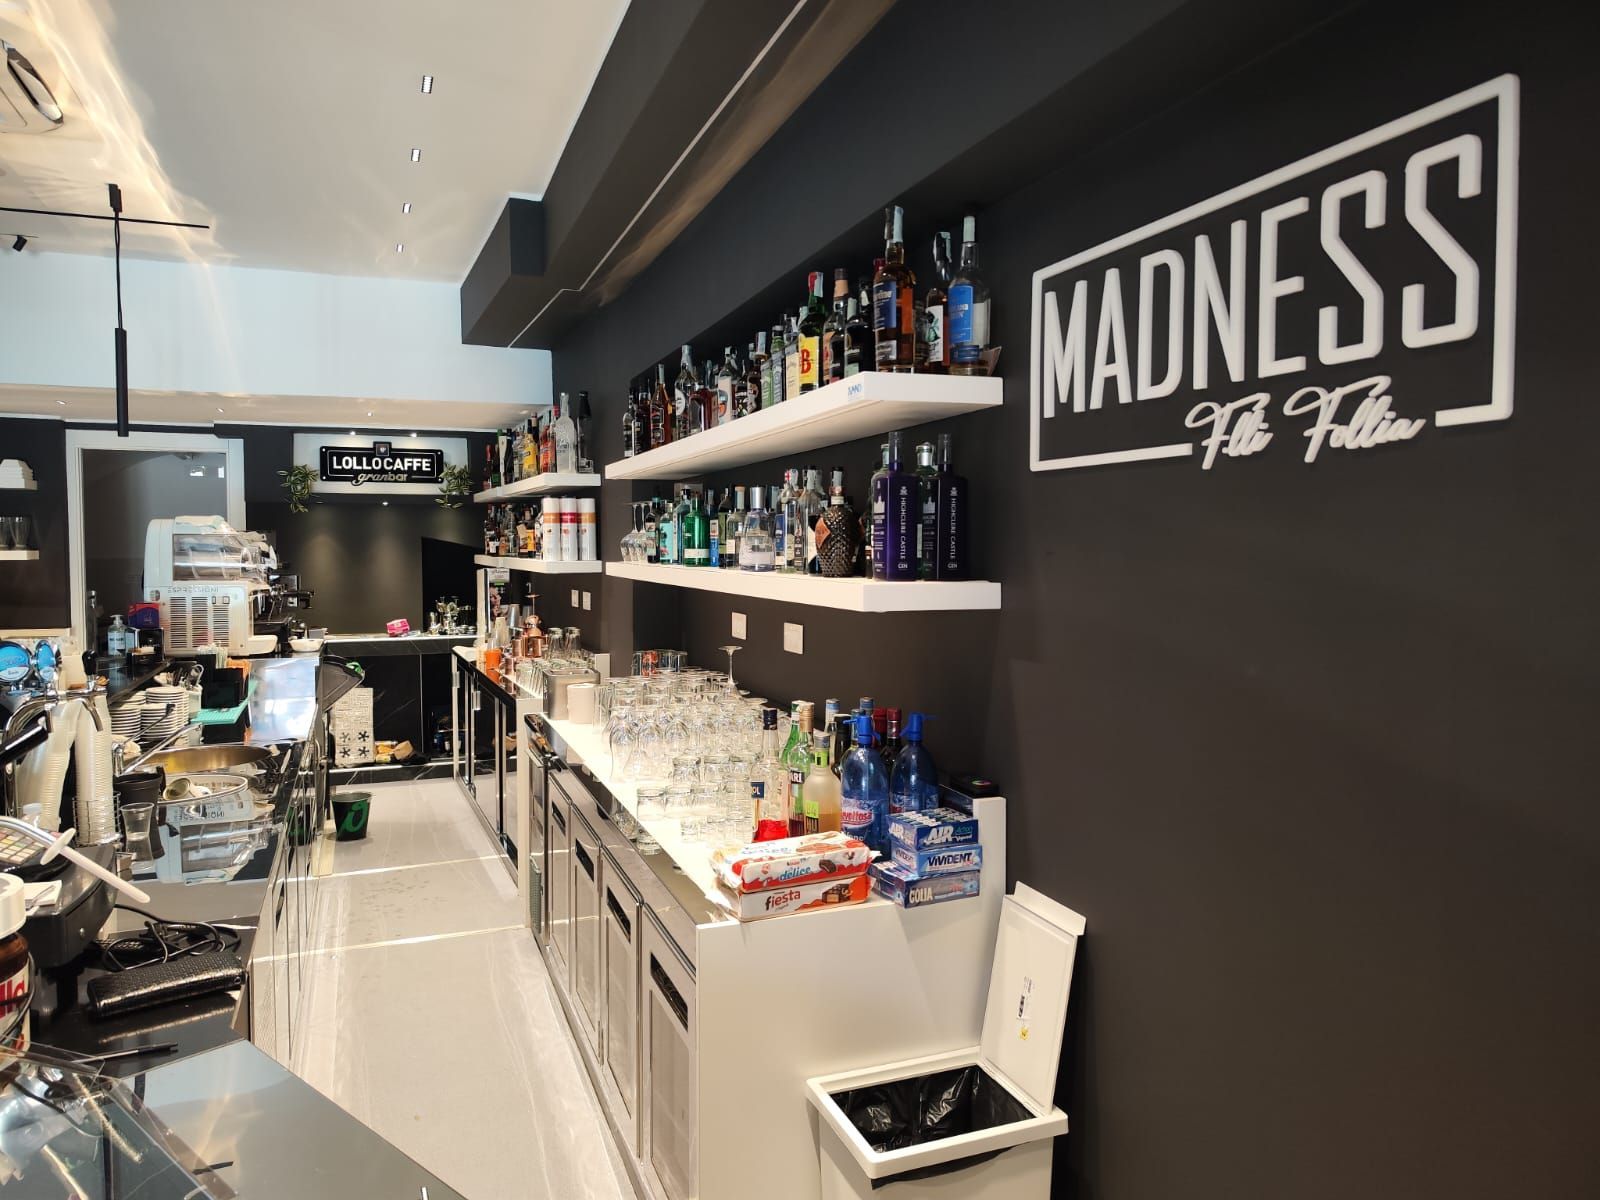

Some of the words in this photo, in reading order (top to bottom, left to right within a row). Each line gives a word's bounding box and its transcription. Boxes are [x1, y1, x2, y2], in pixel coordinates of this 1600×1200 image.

[1044, 133, 1482, 418] MADNESS
[1282, 375, 1427, 463] Follia
[332, 456, 382, 470] LOLLO
[383, 457, 432, 471] CAFFE
[926, 825, 953, 844] AIR
[765, 890, 801, 911] fiesta
[909, 887, 934, 904] GOLIA
